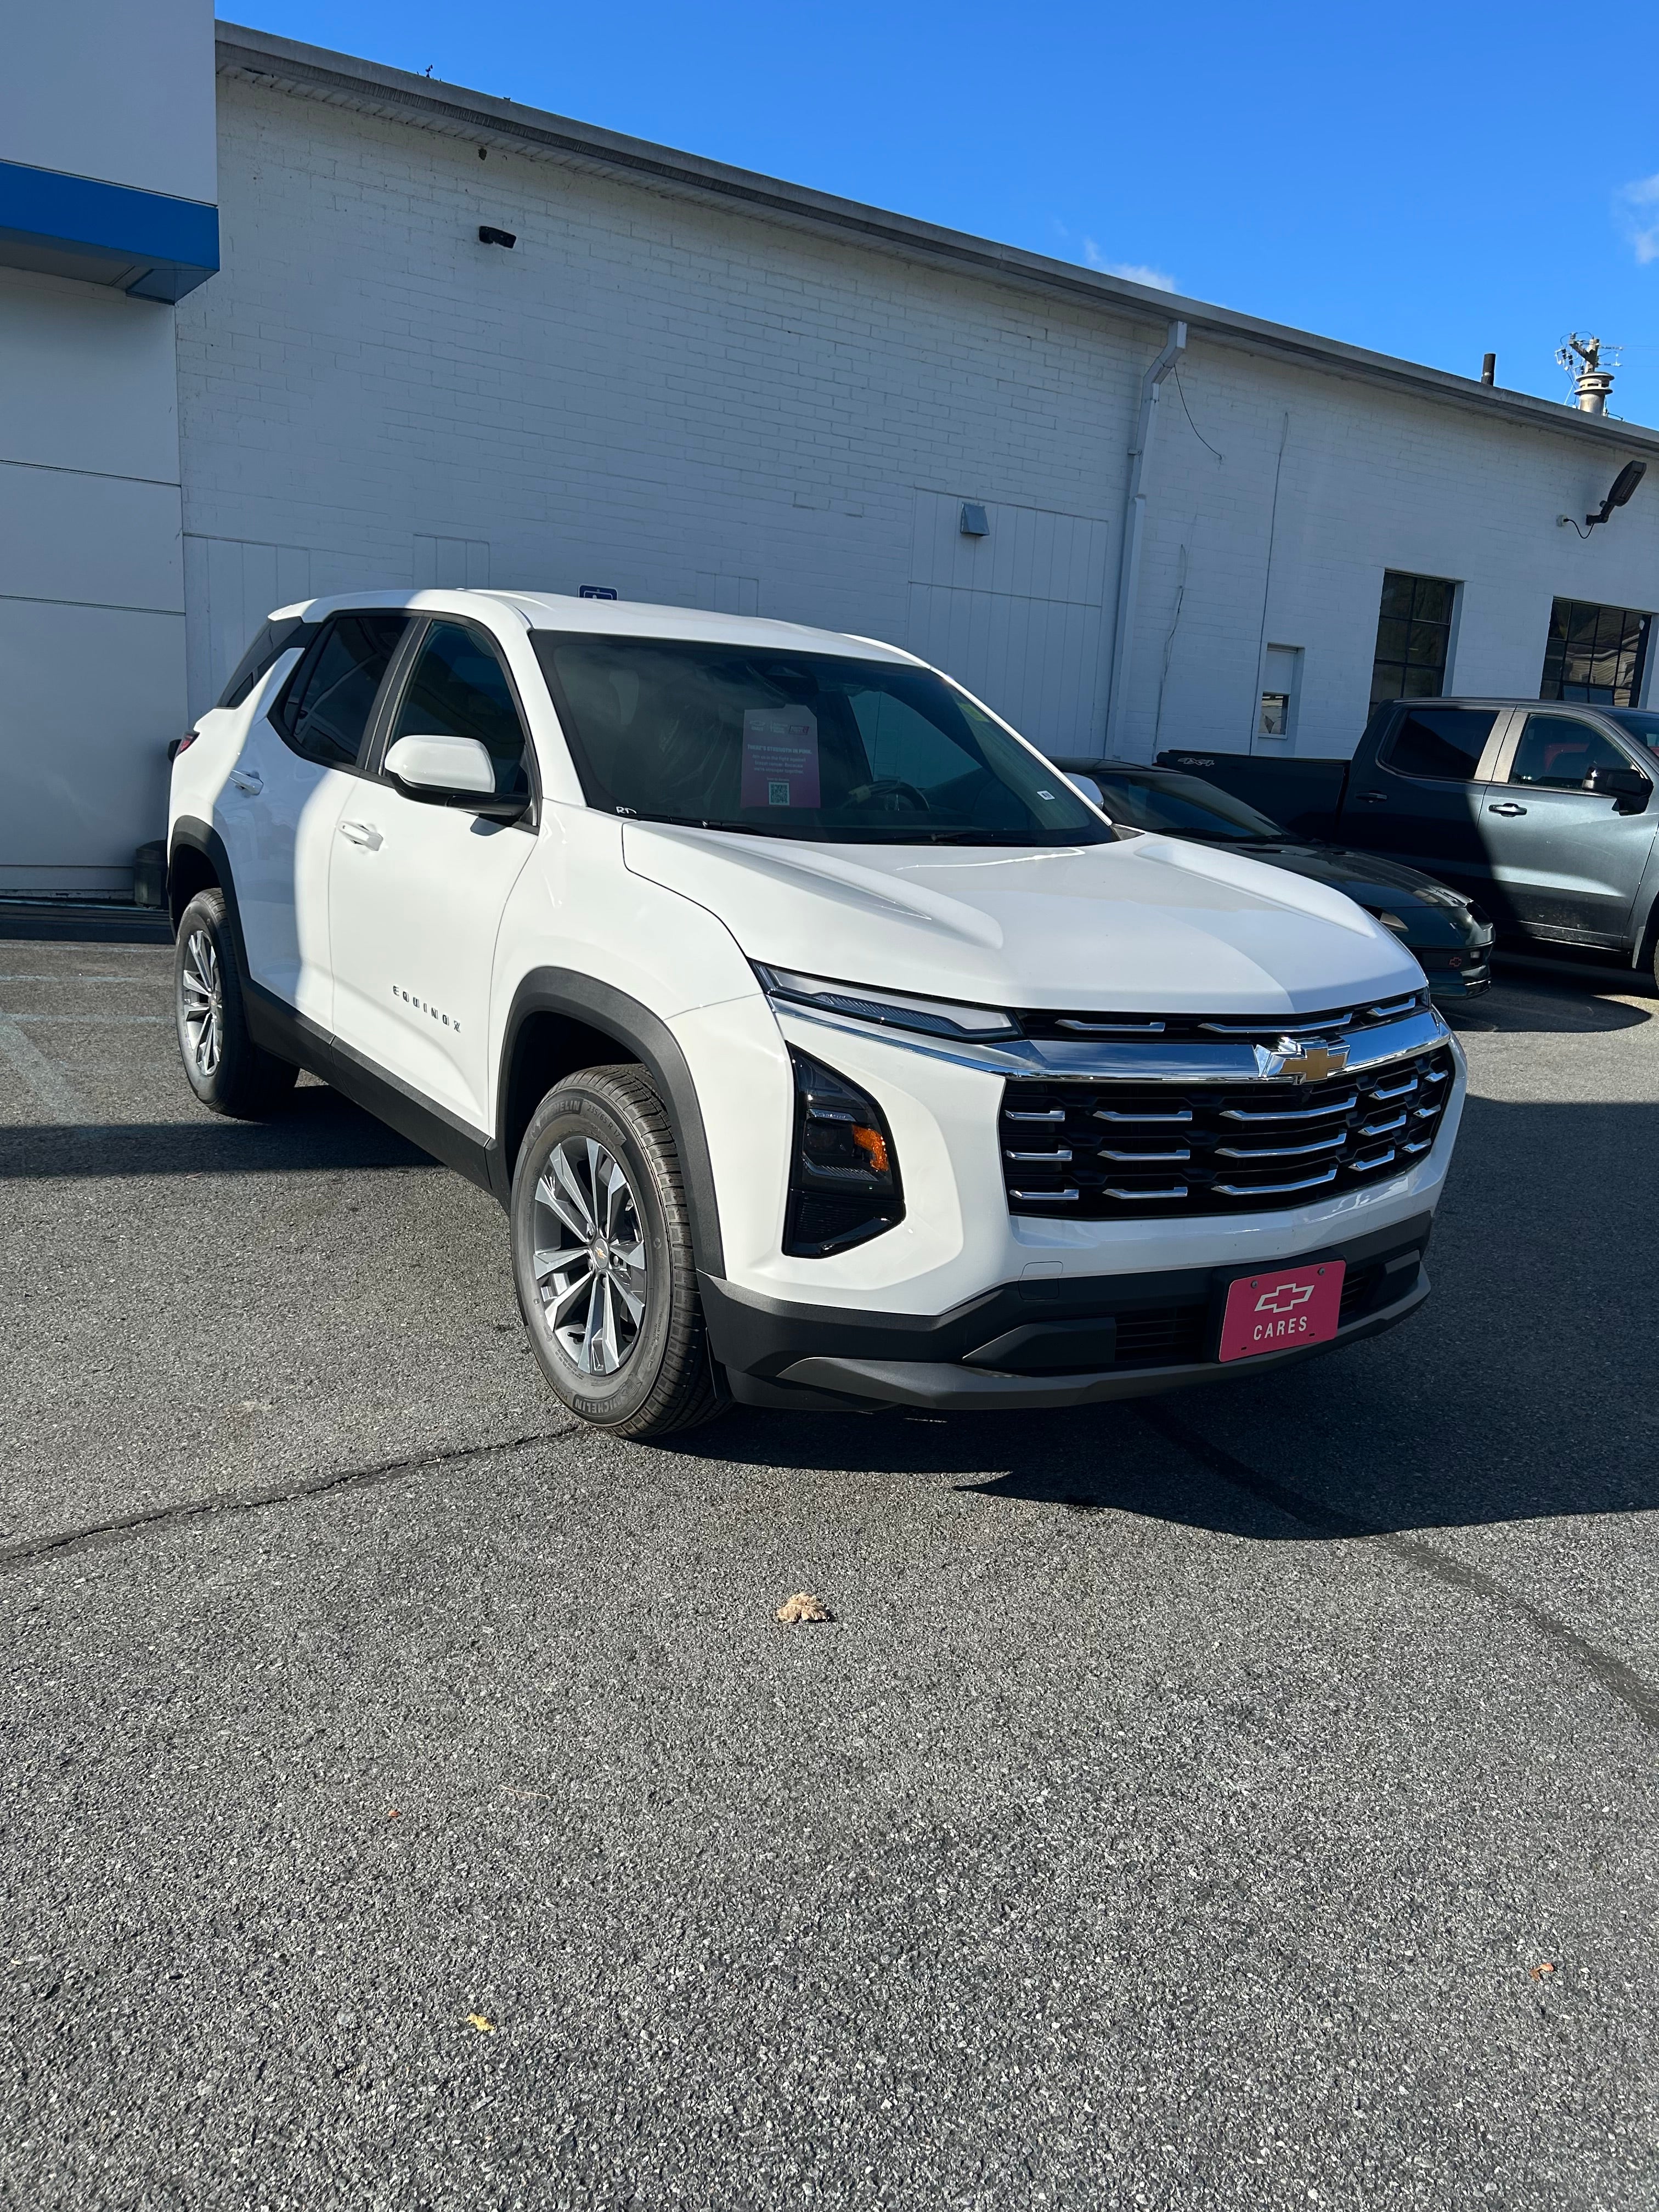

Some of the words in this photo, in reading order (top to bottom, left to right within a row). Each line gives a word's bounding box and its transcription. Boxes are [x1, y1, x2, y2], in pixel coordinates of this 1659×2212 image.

[393, 985, 461, 1033] EQUINOX
[587, 1104, 608, 1124] 235/65
[613, 1129, 621, 1138] 17
[1253, 1316, 1307, 1340] CARES
[574, 1395, 622, 1414] MICHELIN
